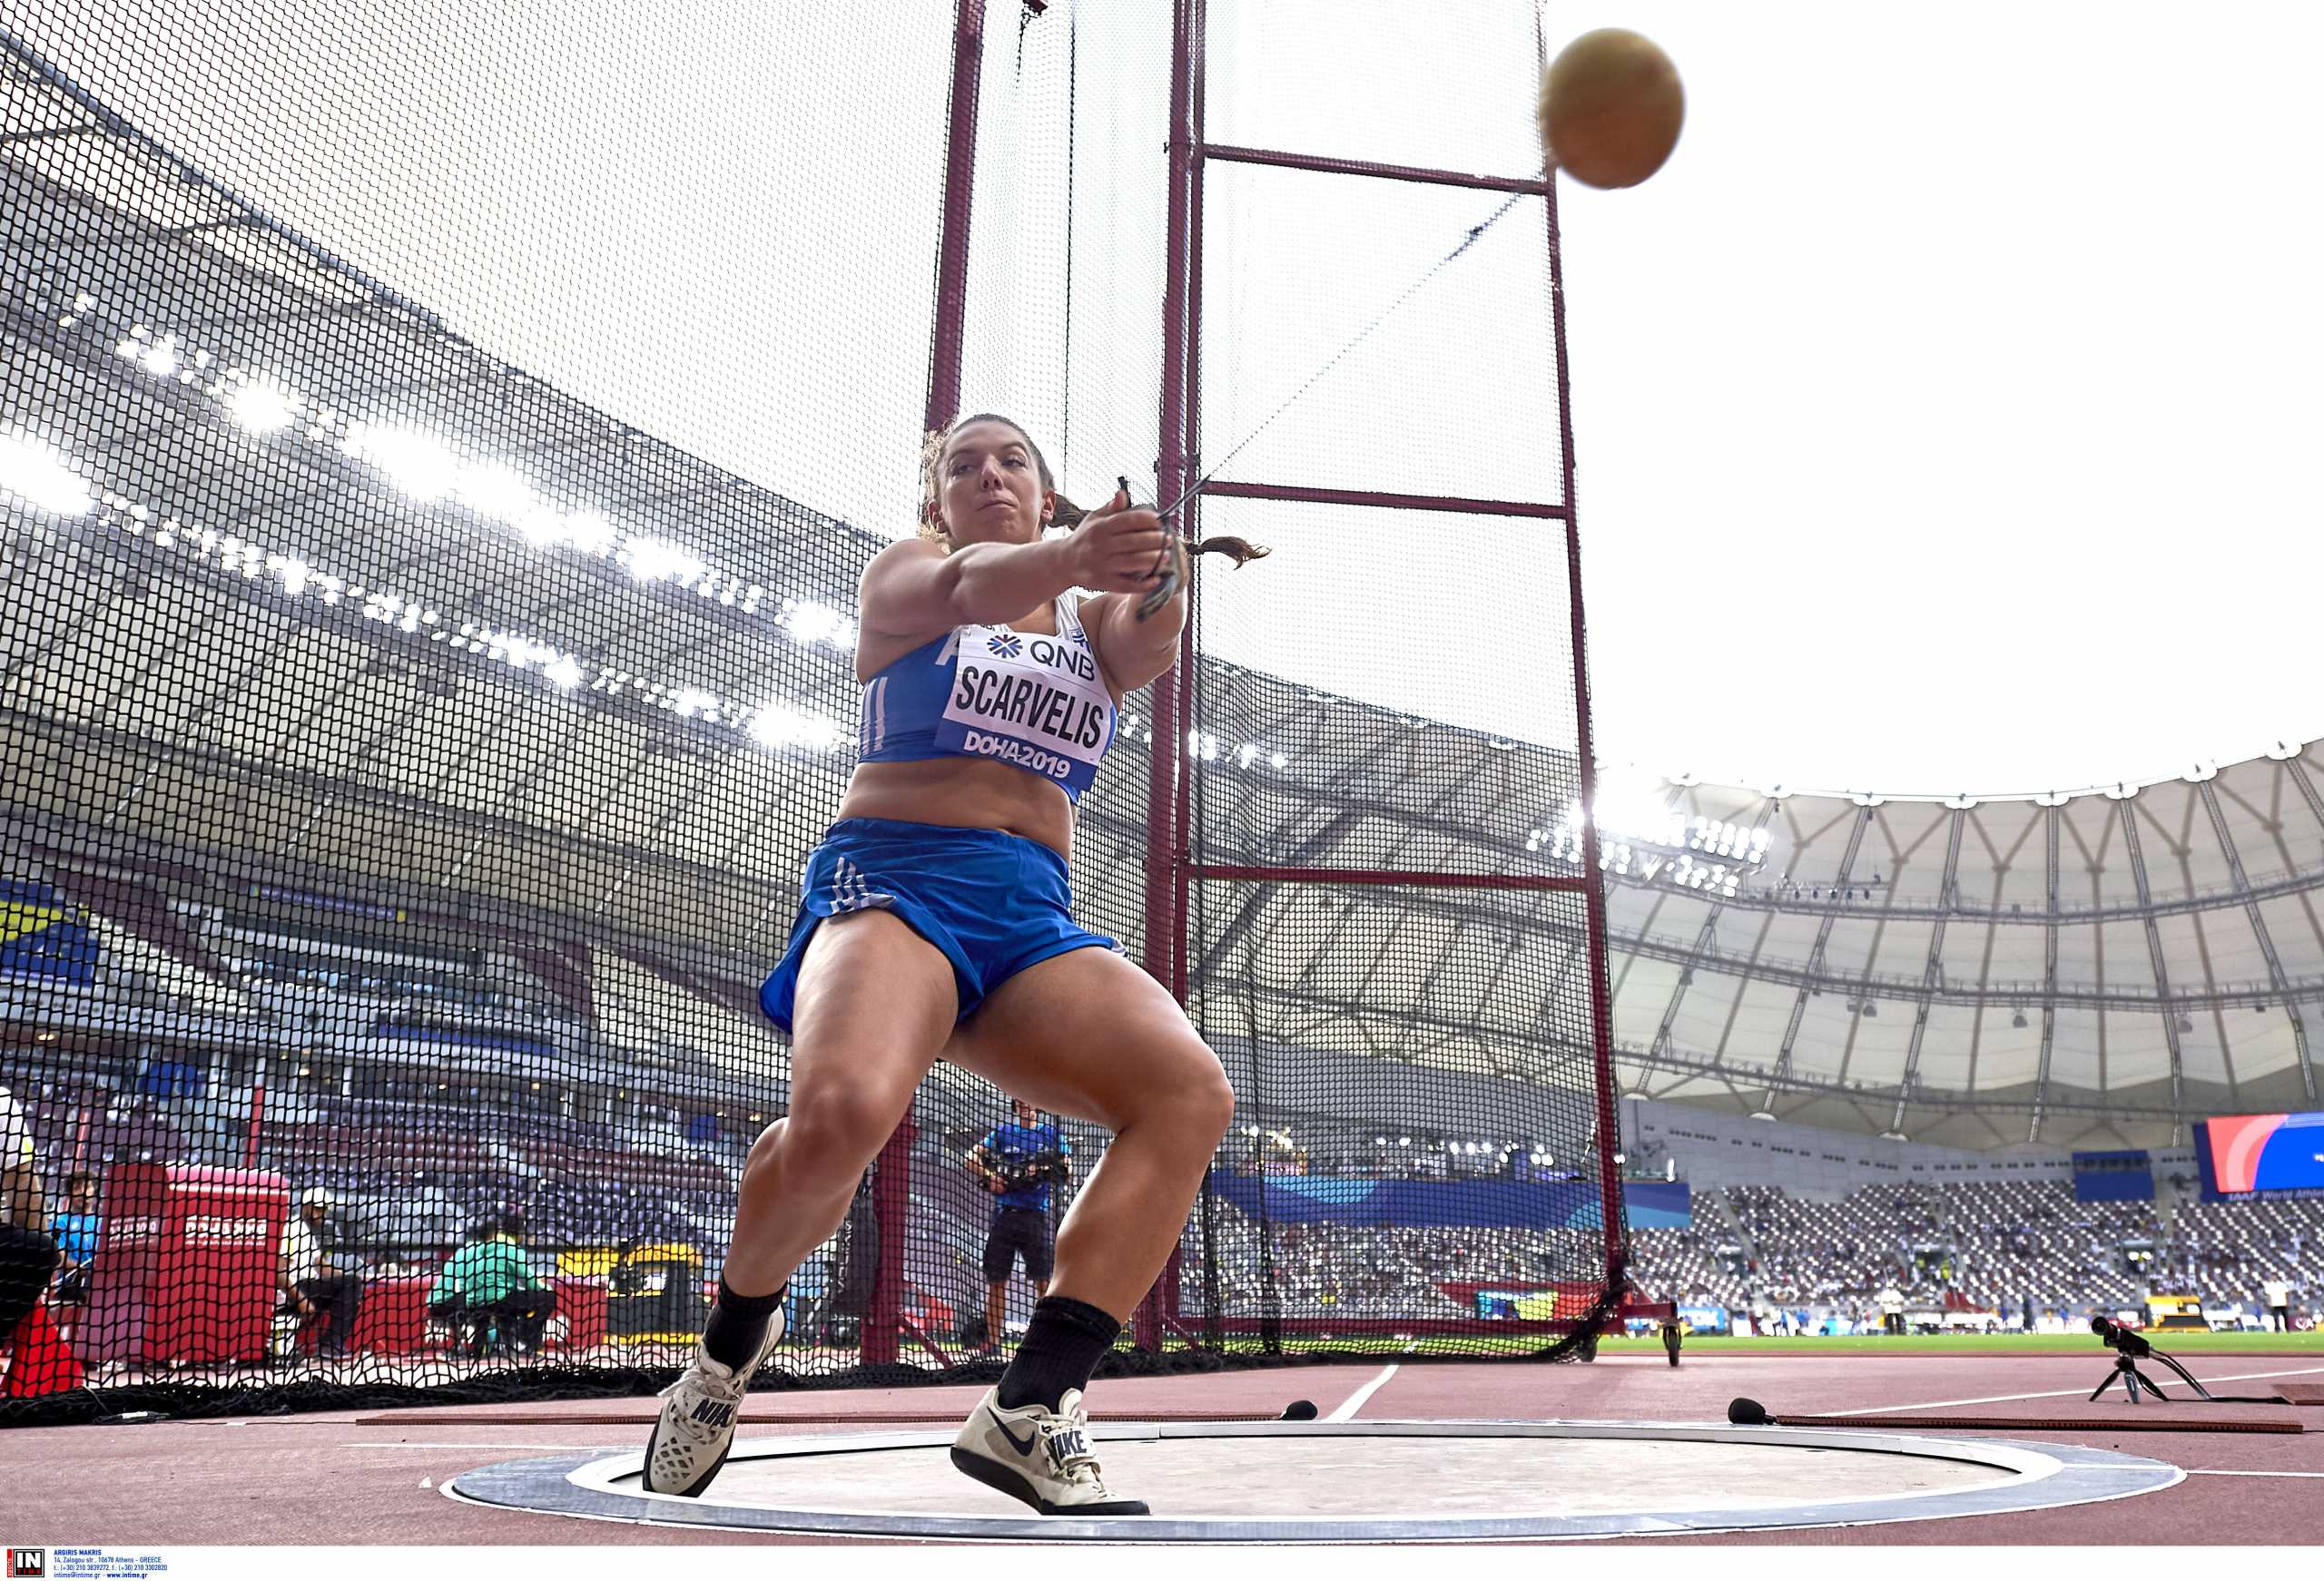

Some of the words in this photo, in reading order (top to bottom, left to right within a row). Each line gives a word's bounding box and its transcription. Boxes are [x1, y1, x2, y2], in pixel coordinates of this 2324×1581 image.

[1029, 640, 1095, 682] QNB
[955, 665, 1104, 749] SCARVELIS
[962, 730, 1071, 780] DOHA2019
